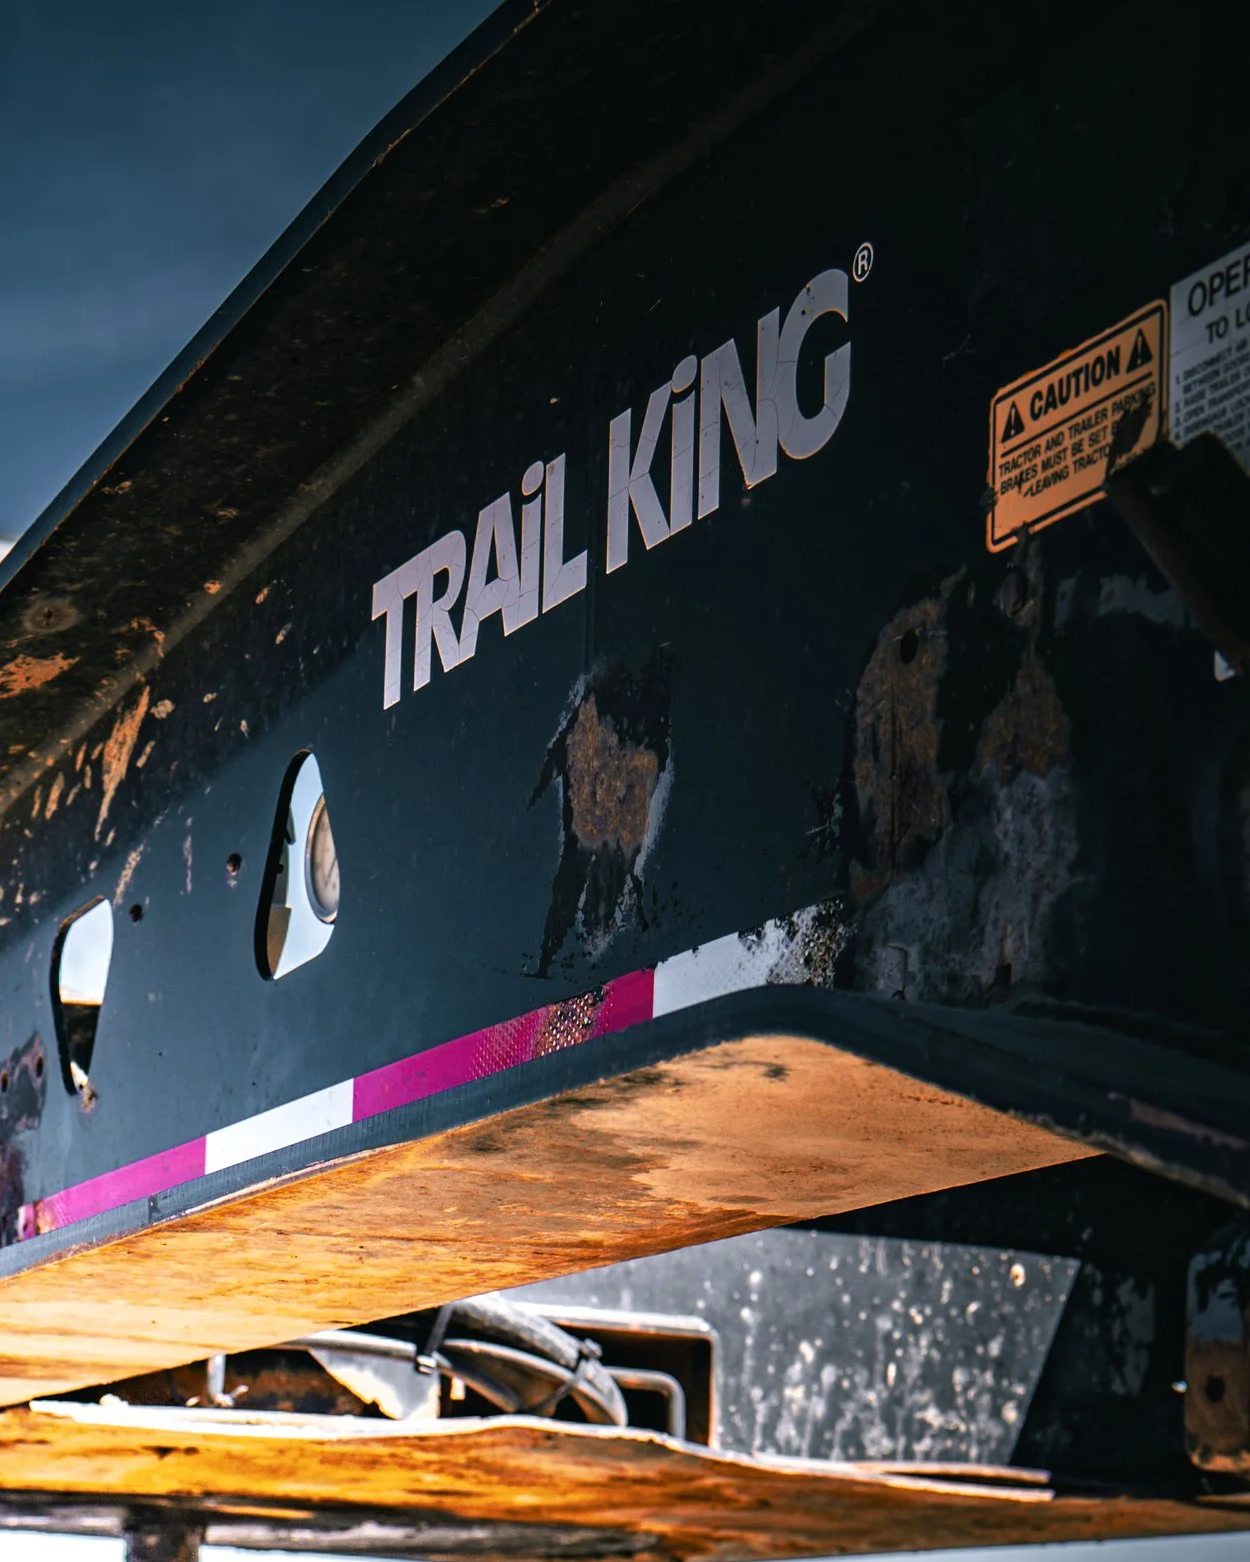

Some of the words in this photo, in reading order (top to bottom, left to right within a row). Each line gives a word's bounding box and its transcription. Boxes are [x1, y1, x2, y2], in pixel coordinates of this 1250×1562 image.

[1205, 315, 1229, 344] TO
[1030, 345, 1121, 421] CAUTION
[998, 444, 1041, 477] TRACTOR
[1045, 431, 1065, 453] AND
[1068, 407, 1108, 440] TRAILER
[1000, 464, 1038, 495] BRAKES
[1041, 447, 1068, 473] MUST
[1071, 438, 1084, 456] BE
[1088, 425, 1108, 448] SET
[1029, 465, 1069, 497] LEAVING
[1073, 443, 1110, 473] TRACTO
